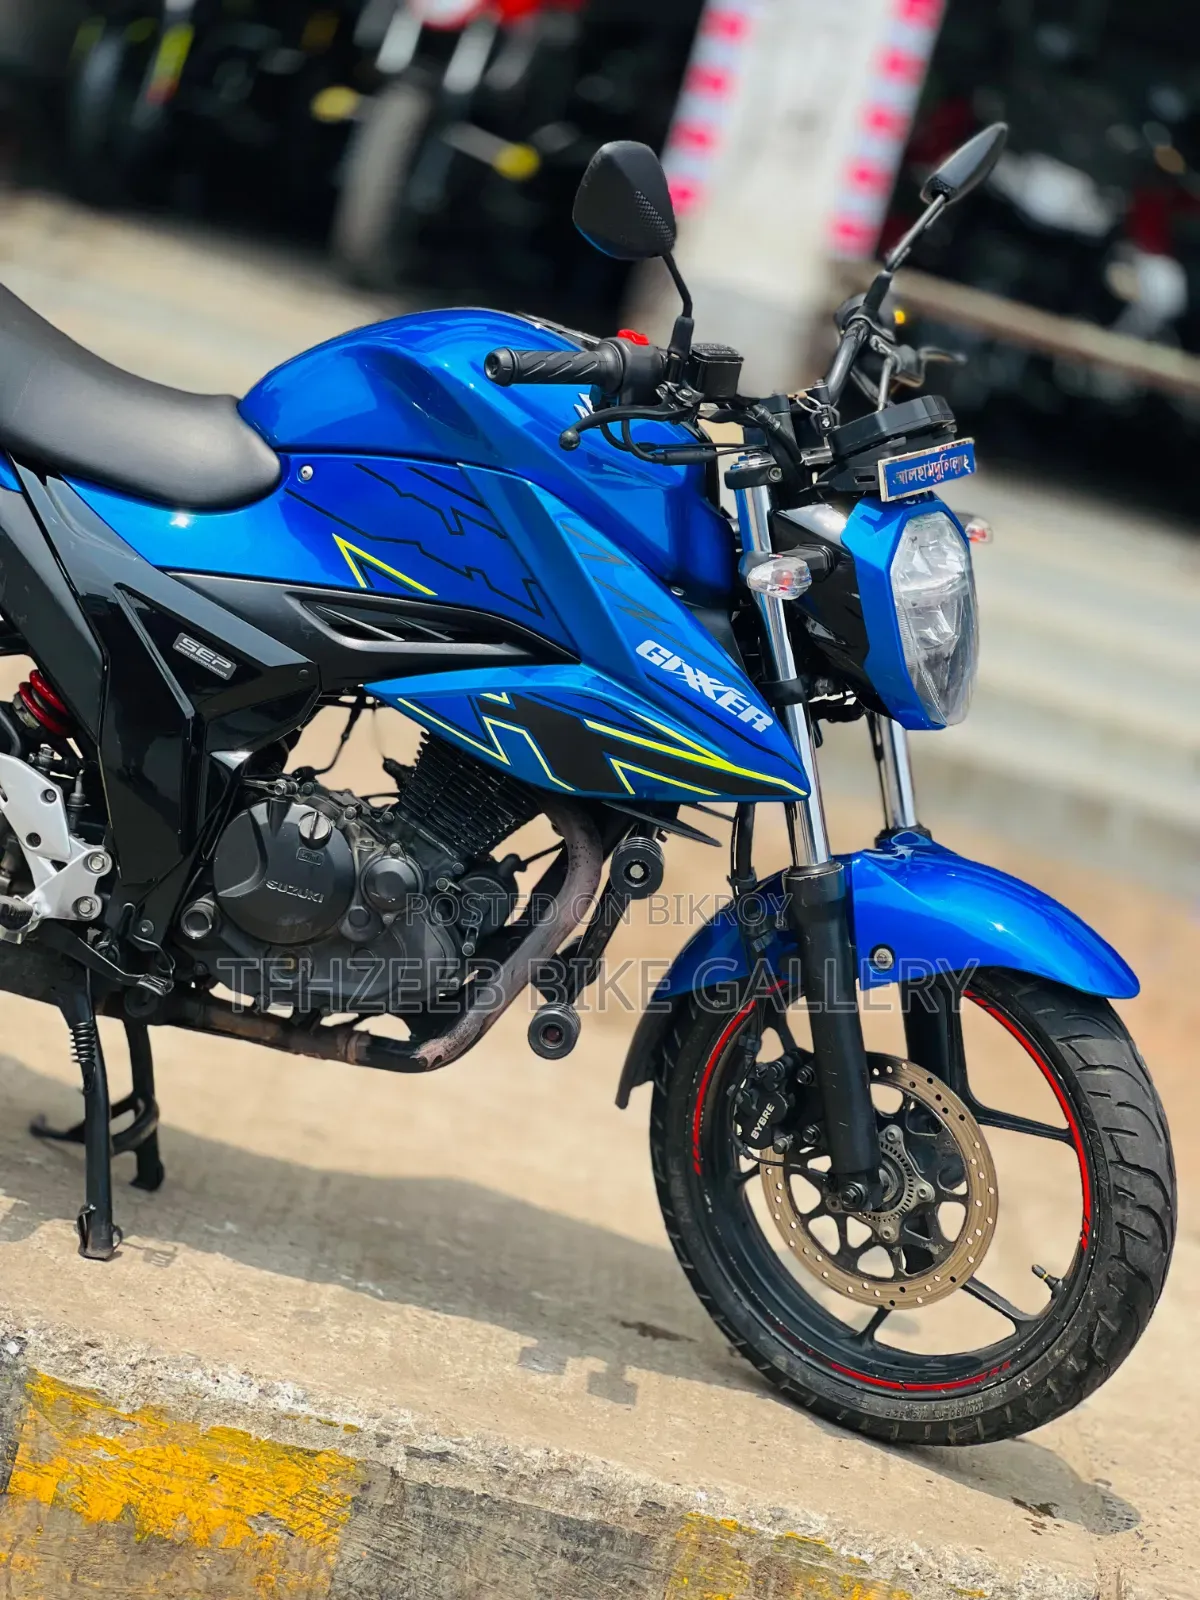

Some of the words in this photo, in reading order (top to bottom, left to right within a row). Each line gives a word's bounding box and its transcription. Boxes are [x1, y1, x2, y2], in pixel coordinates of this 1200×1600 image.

[178, 637, 232, 669] SEP
[635, 639, 774, 733] GIXXER
[265, 879, 325, 904] SUZUKI
[750, 1102, 775, 1140] BYBRE
